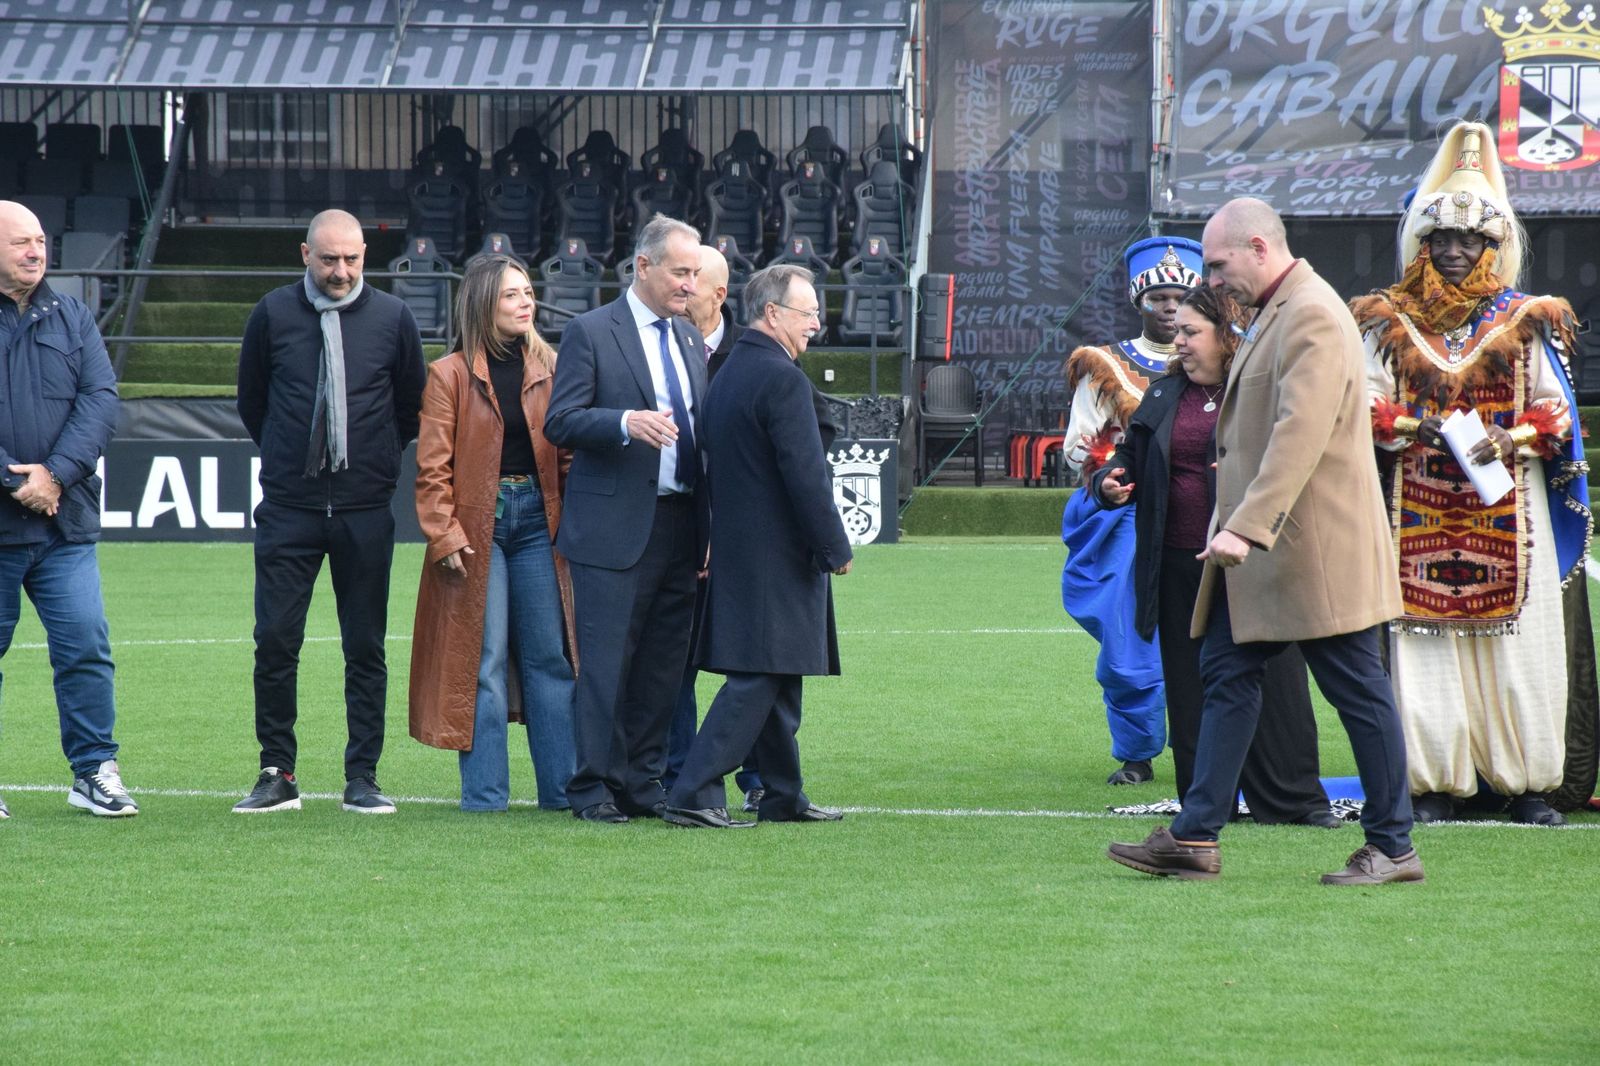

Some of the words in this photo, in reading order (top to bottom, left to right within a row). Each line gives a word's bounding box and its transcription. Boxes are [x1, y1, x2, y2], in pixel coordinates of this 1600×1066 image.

[996, 15, 1104, 50] RUGE
[1005, 63, 1065, 82] INDES
[1011, 80, 1059, 99] TRUC
[1181, 54, 1502, 128] CABALLA
[1010, 99, 1059, 117] TIBLE
[1008, 129, 1032, 237] FUERZA
[1289, 172, 1420, 193] PORQU
[1289, 190, 1377, 206] AMO
[1038, 141, 1064, 290] IMPARABLE
[1006, 240, 1034, 300] UNA
[953, 304, 1070, 328] SIEMPRE
[993, 361, 1067, 378] FUERZ
